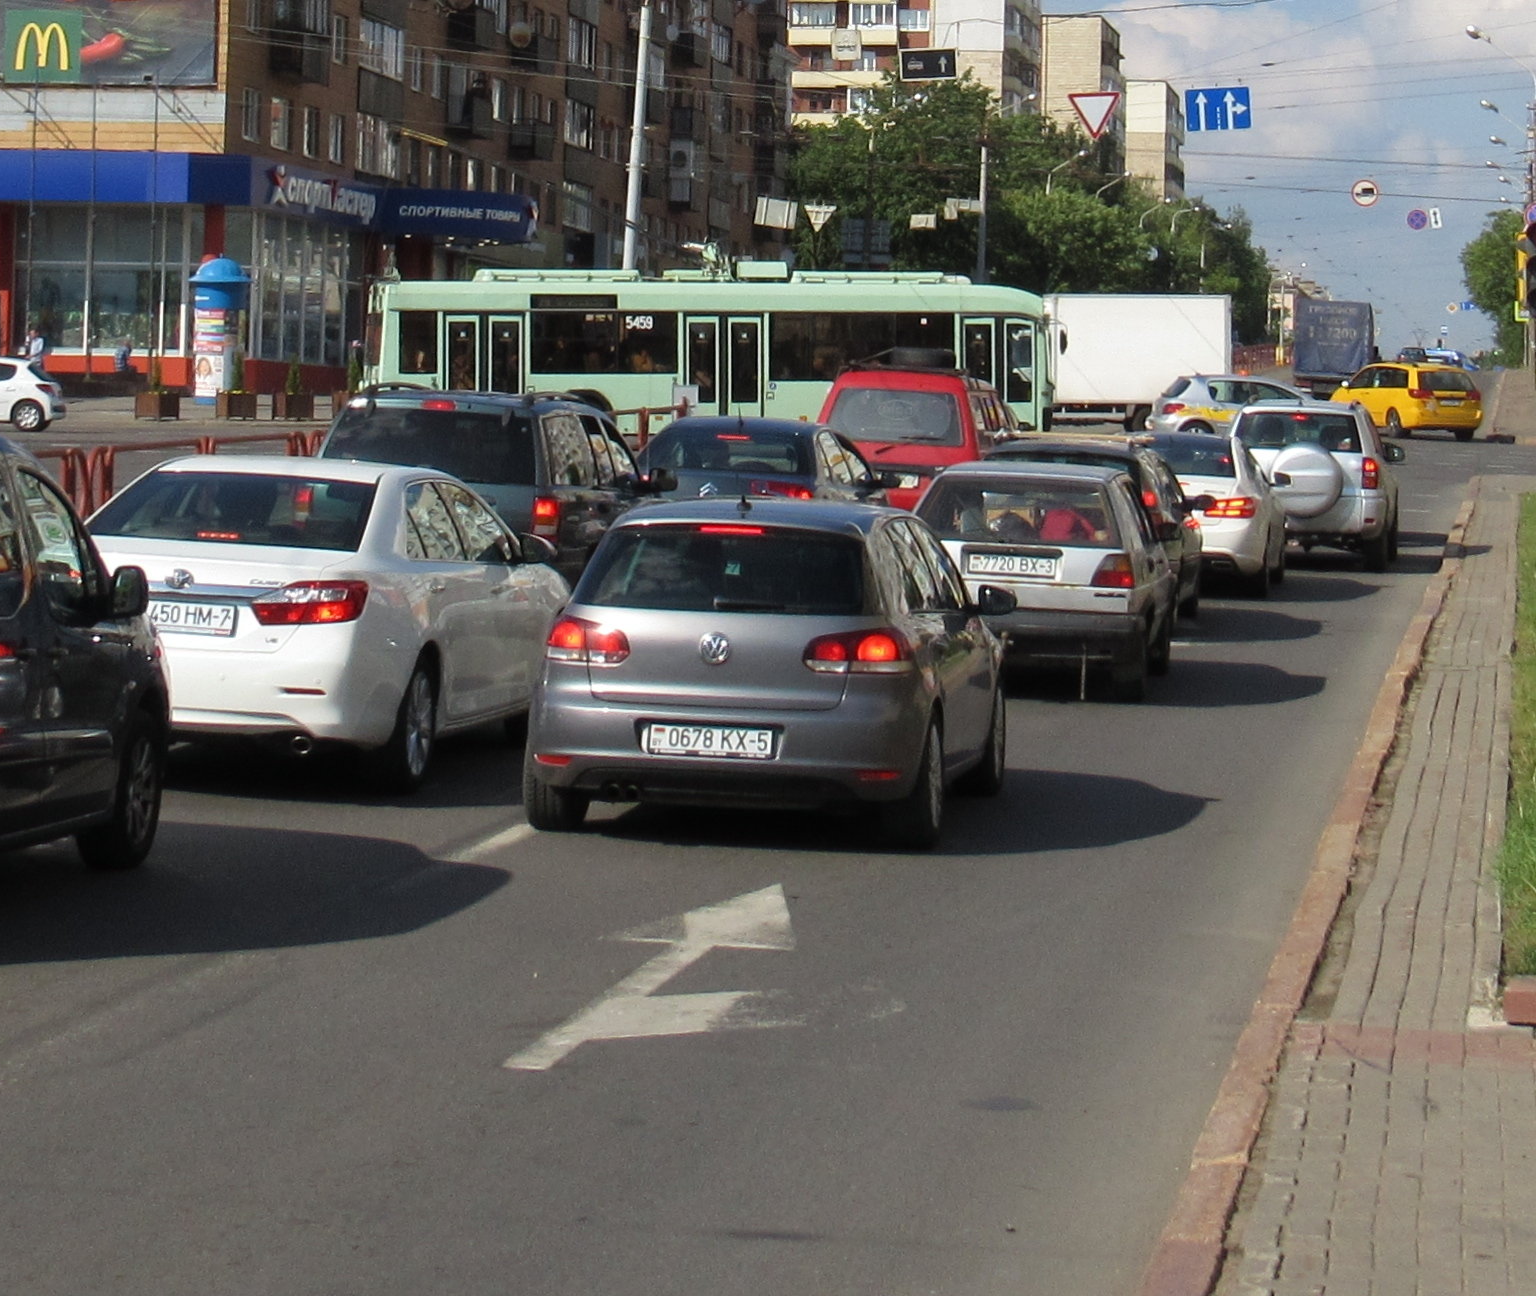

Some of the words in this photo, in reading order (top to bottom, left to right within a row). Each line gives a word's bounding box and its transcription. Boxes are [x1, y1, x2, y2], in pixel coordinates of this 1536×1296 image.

[399, 205, 484, 220] СПОРТИВНЫЕ
[485, 208, 521, 223] ТОВАРЫ
[625, 315, 653, 331] 5459
[982, 555, 1015, 571] 7720
[1019, 559, 1053, 574] BX-3
[184, 605, 230, 627] HM-7
[668, 727, 714, 748] 0678
[720, 730, 768, 752] KX-5
